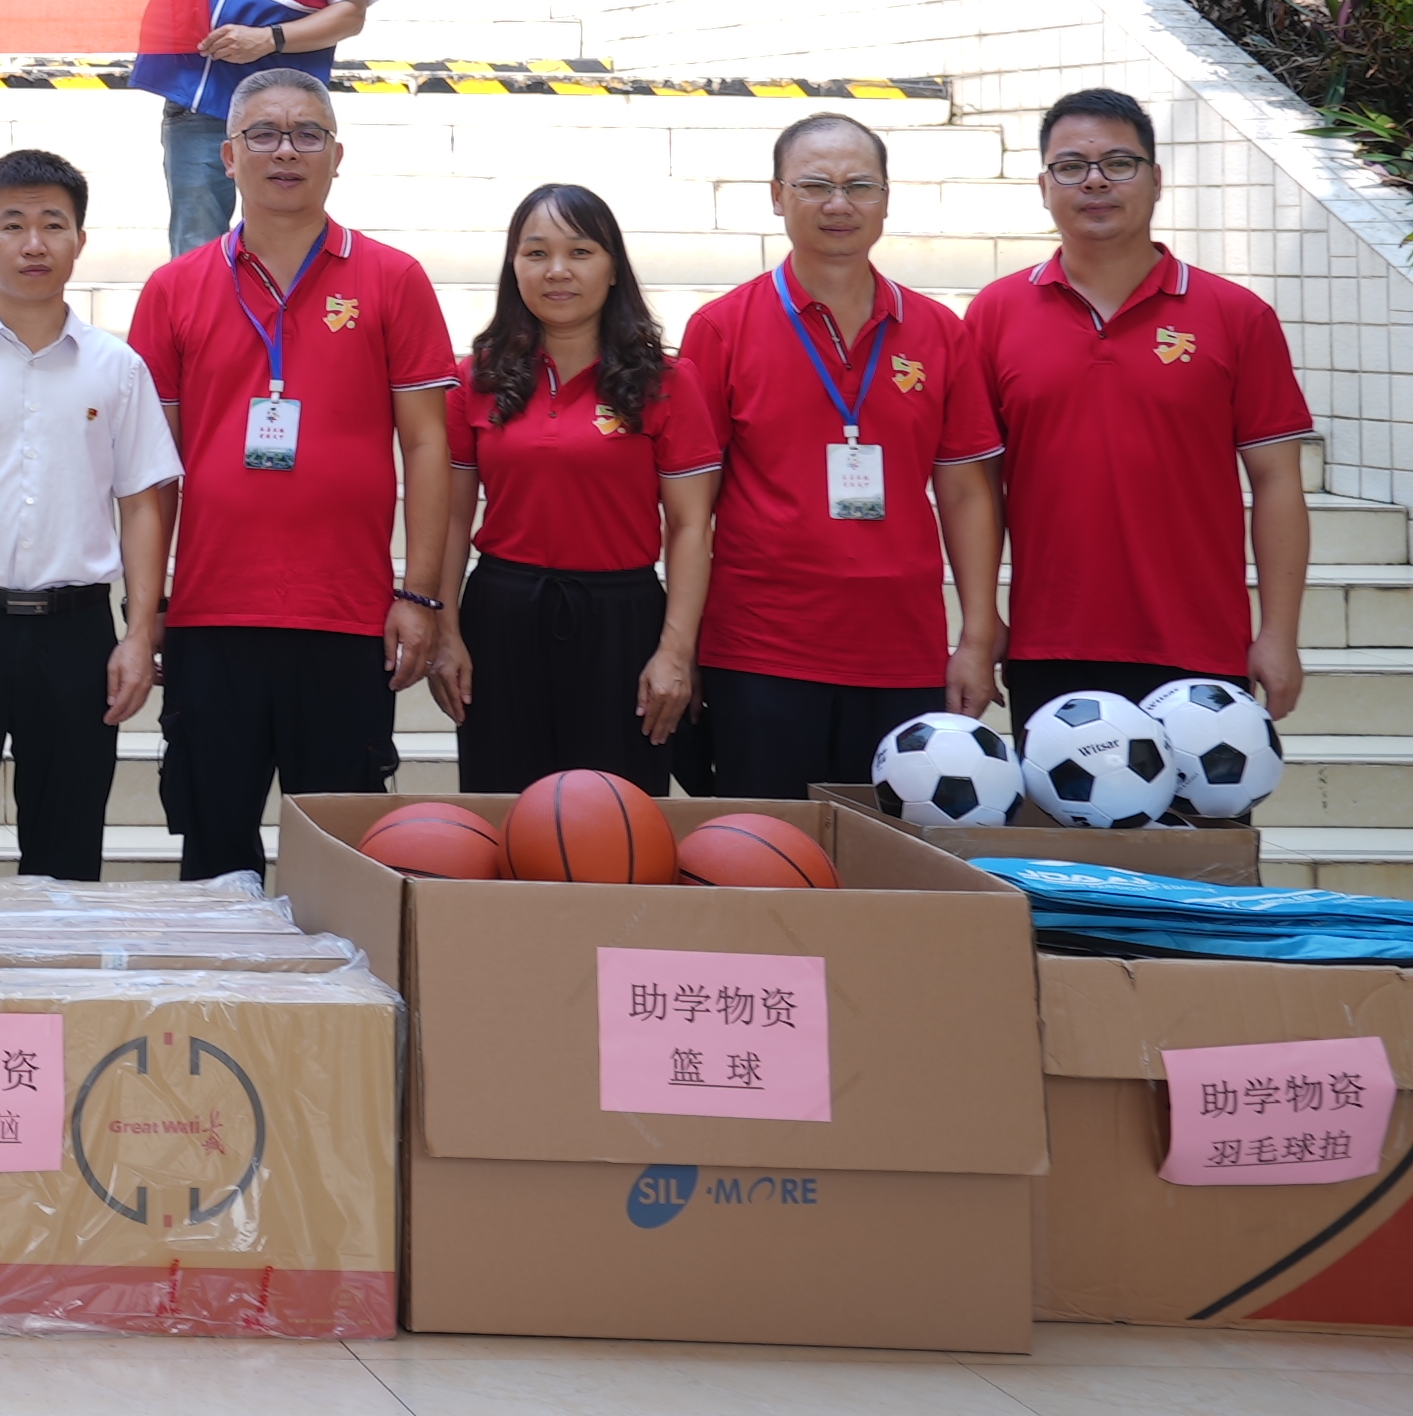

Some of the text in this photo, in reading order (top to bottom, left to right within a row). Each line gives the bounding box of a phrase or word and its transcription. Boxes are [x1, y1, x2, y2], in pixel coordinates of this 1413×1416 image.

[1077, 739, 1120, 757] Witsar
[628, 982, 798, 1029] 助学物资
[1199, 1071, 1367, 1117] 助学物资
[108, 1119, 200, 1134] Great Wall
[1204, 1130, 1352, 1168] 羽毛球拍
[638, 1177, 685, 1205] SIL
